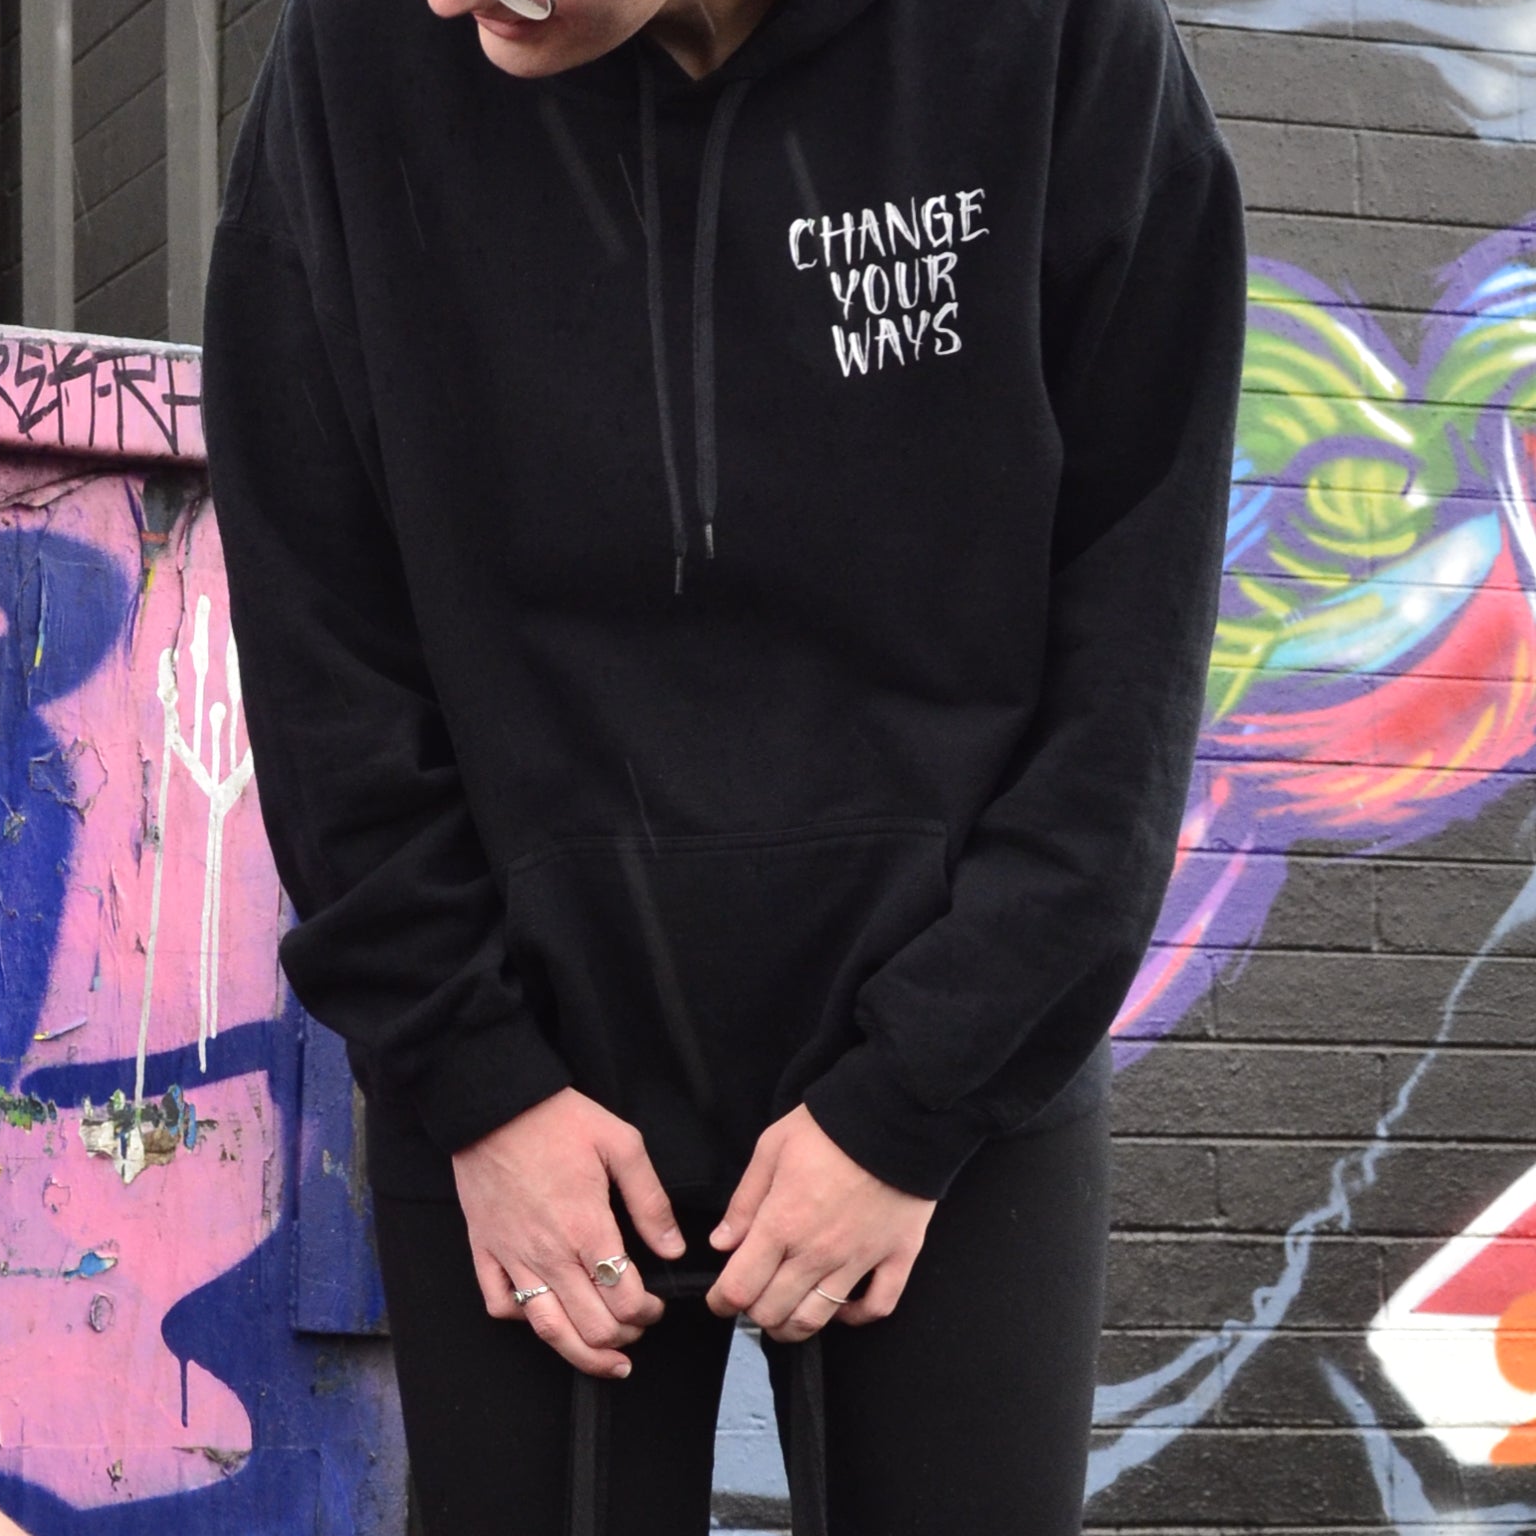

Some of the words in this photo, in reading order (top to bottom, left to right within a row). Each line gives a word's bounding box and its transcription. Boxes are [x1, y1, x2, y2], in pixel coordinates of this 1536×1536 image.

[788, 187, 990, 271] CHANGE
[830, 251, 958, 321] YOUR
[831, 301, 963, 378] WAYS
